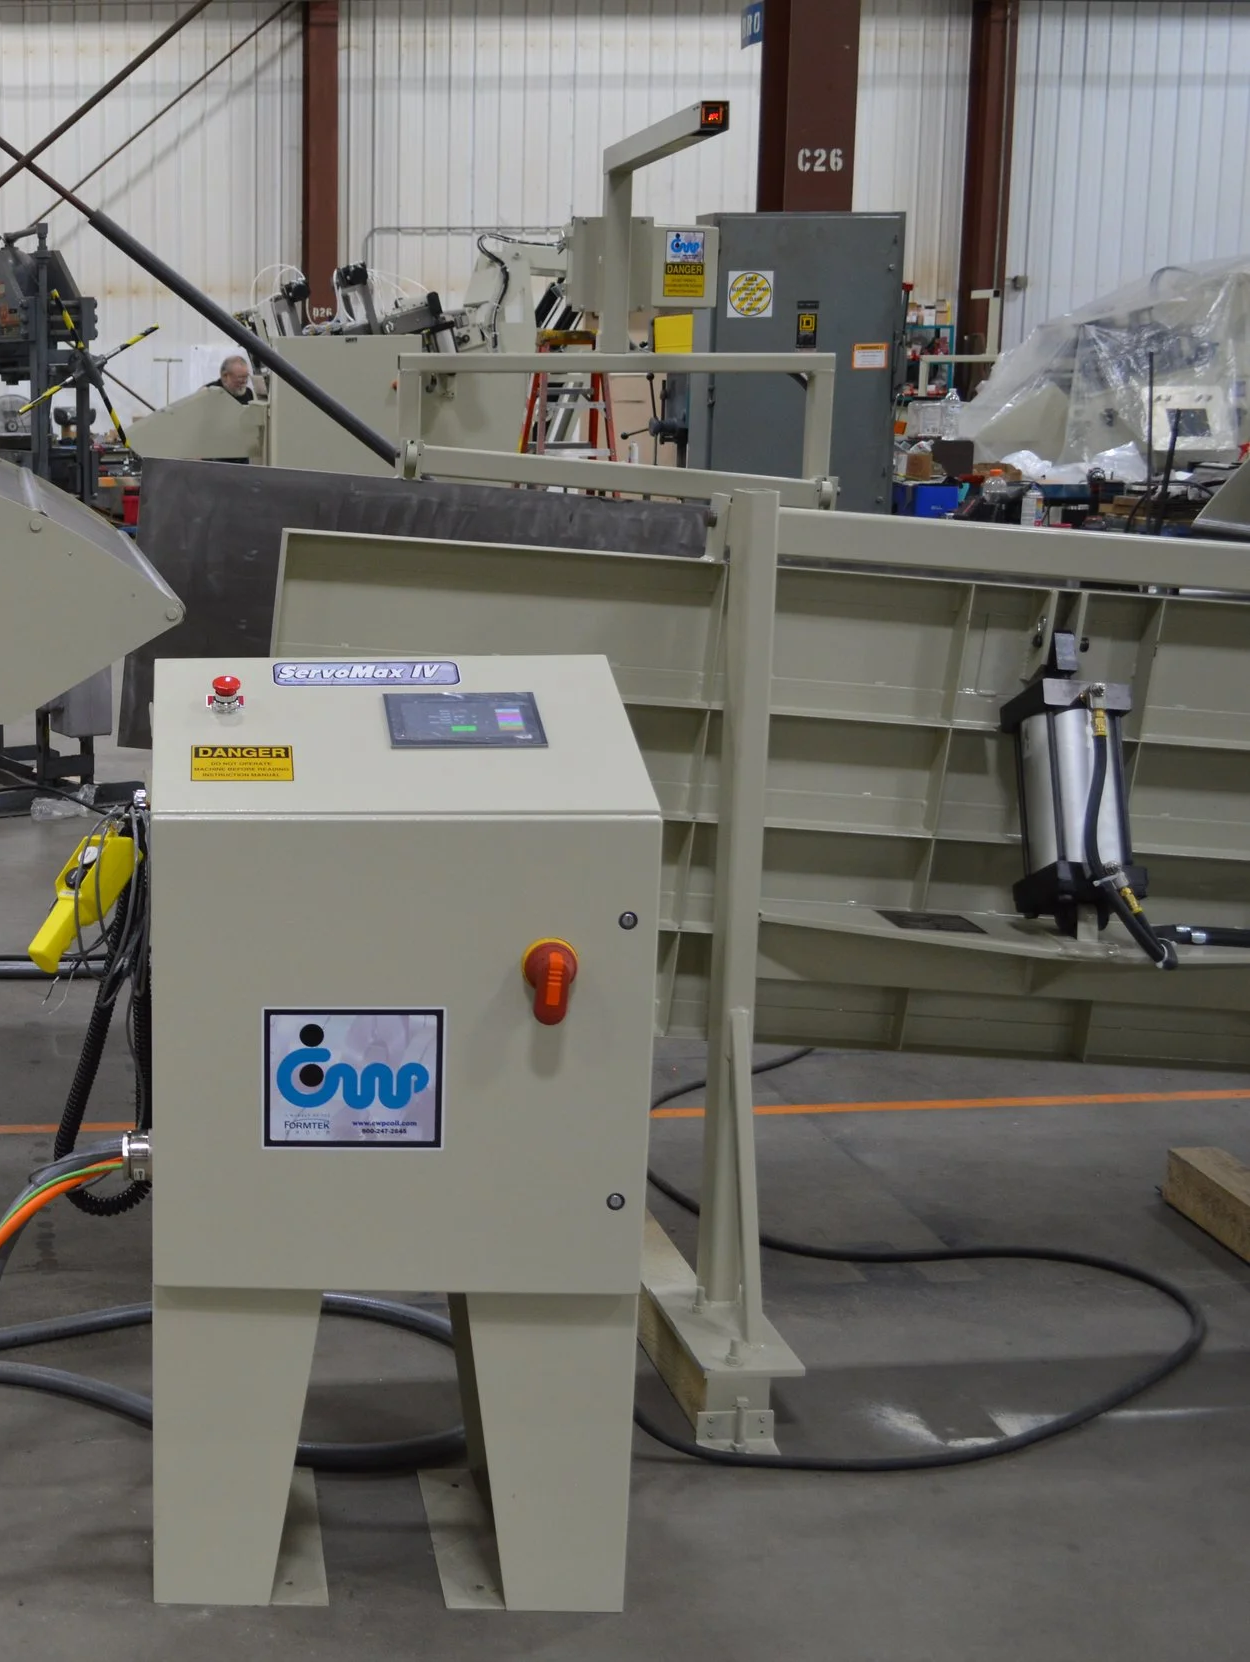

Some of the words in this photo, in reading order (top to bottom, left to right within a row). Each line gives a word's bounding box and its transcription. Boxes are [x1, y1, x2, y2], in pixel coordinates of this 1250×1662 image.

[797, 148, 843, 172] C26
[667, 264, 703, 275] DANGER
[278, 663, 405, 679] ServoMax
[410, 663, 441, 678] IV
[198, 747, 286, 758] DANGER
[284, 1120, 330, 1130] FORMTEK
